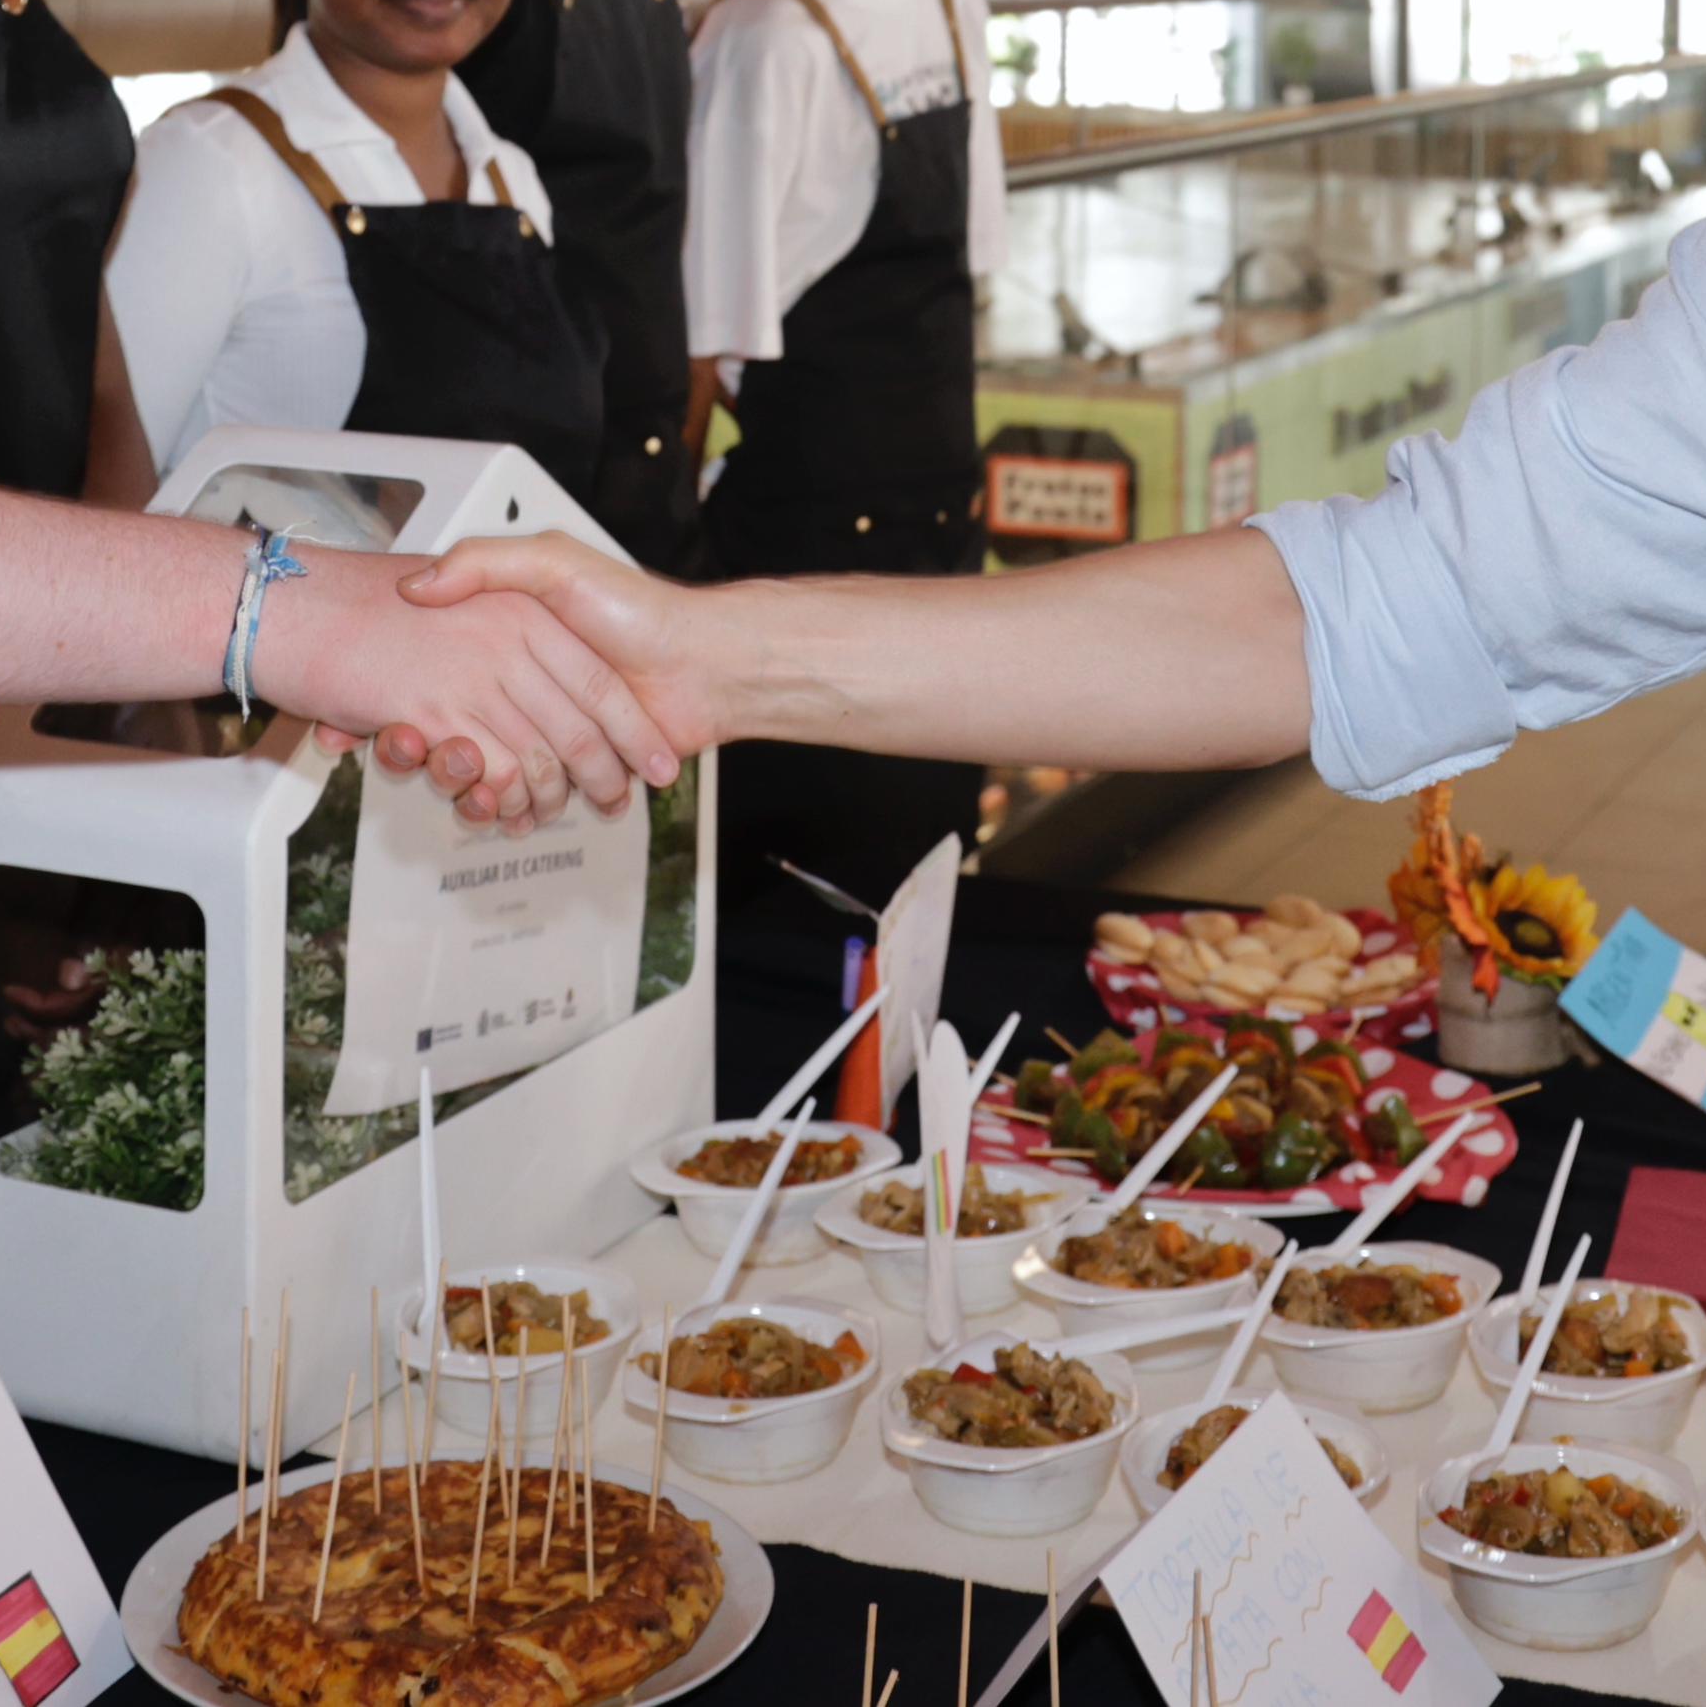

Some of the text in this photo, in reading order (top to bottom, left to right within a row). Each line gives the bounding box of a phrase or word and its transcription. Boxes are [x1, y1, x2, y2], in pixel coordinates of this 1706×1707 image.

[438, 847, 584, 893] AUXILIAR DE CATERING
[1252, 1450, 1300, 1509] DE
[1273, 1536, 1326, 1604] CON
